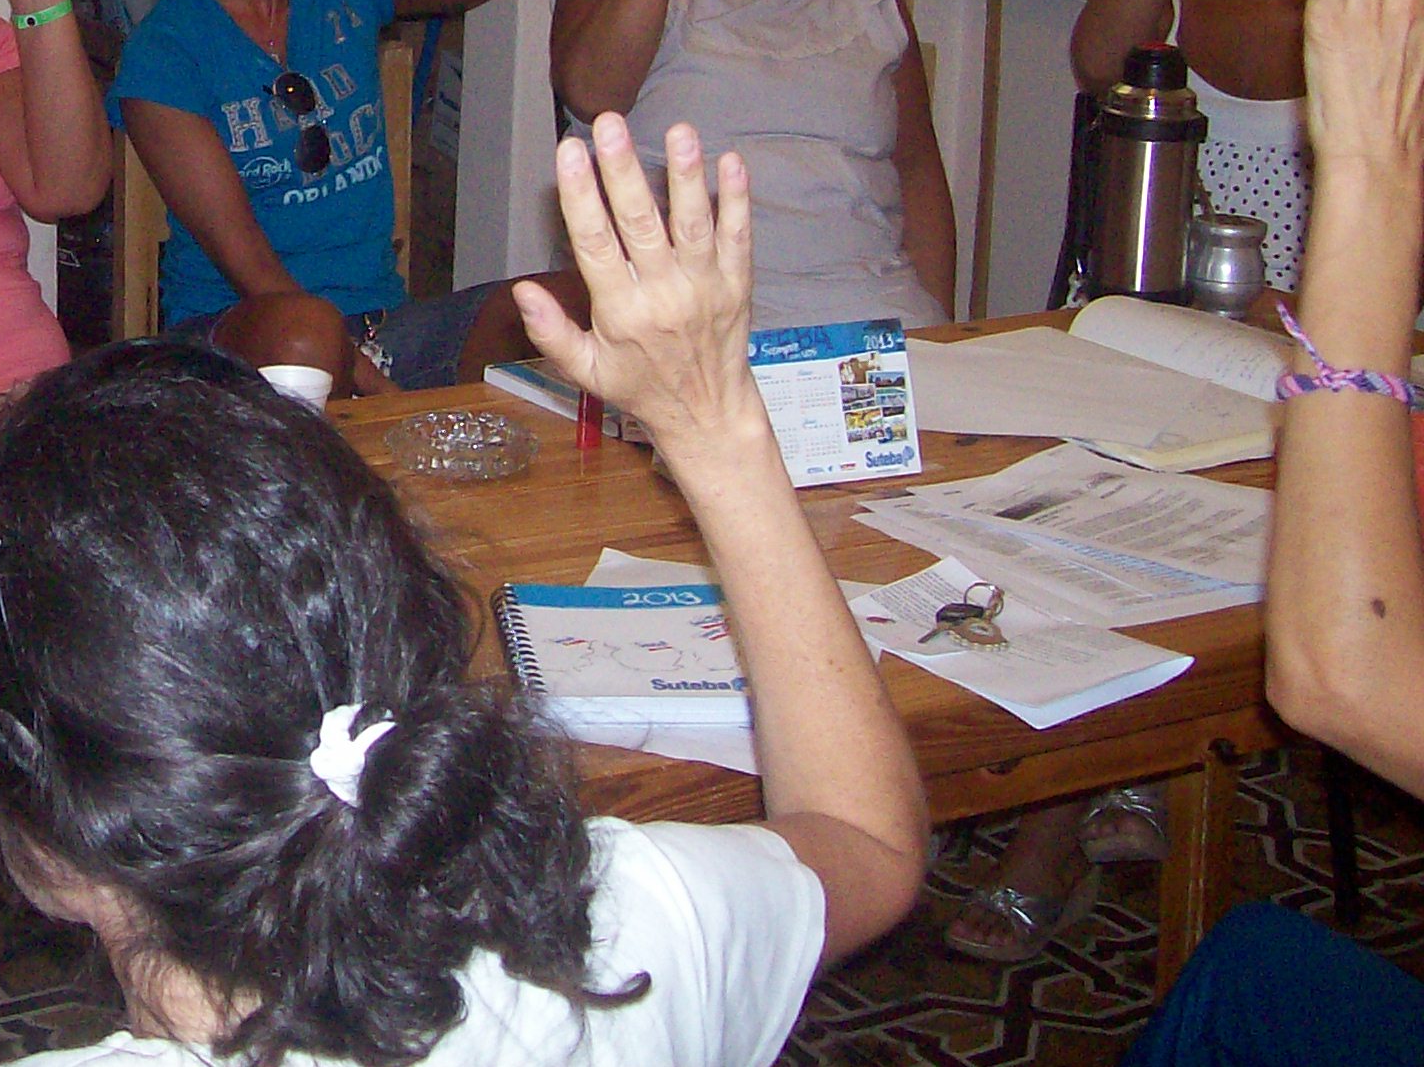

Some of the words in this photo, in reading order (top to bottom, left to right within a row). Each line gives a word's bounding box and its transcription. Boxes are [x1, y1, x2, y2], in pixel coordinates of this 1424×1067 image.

[862, 333, 894, 351] 2013
[865, 450, 904, 468] Suteba
[622, 591, 703, 606] 2013
[650, 678, 732, 691] Suteba
